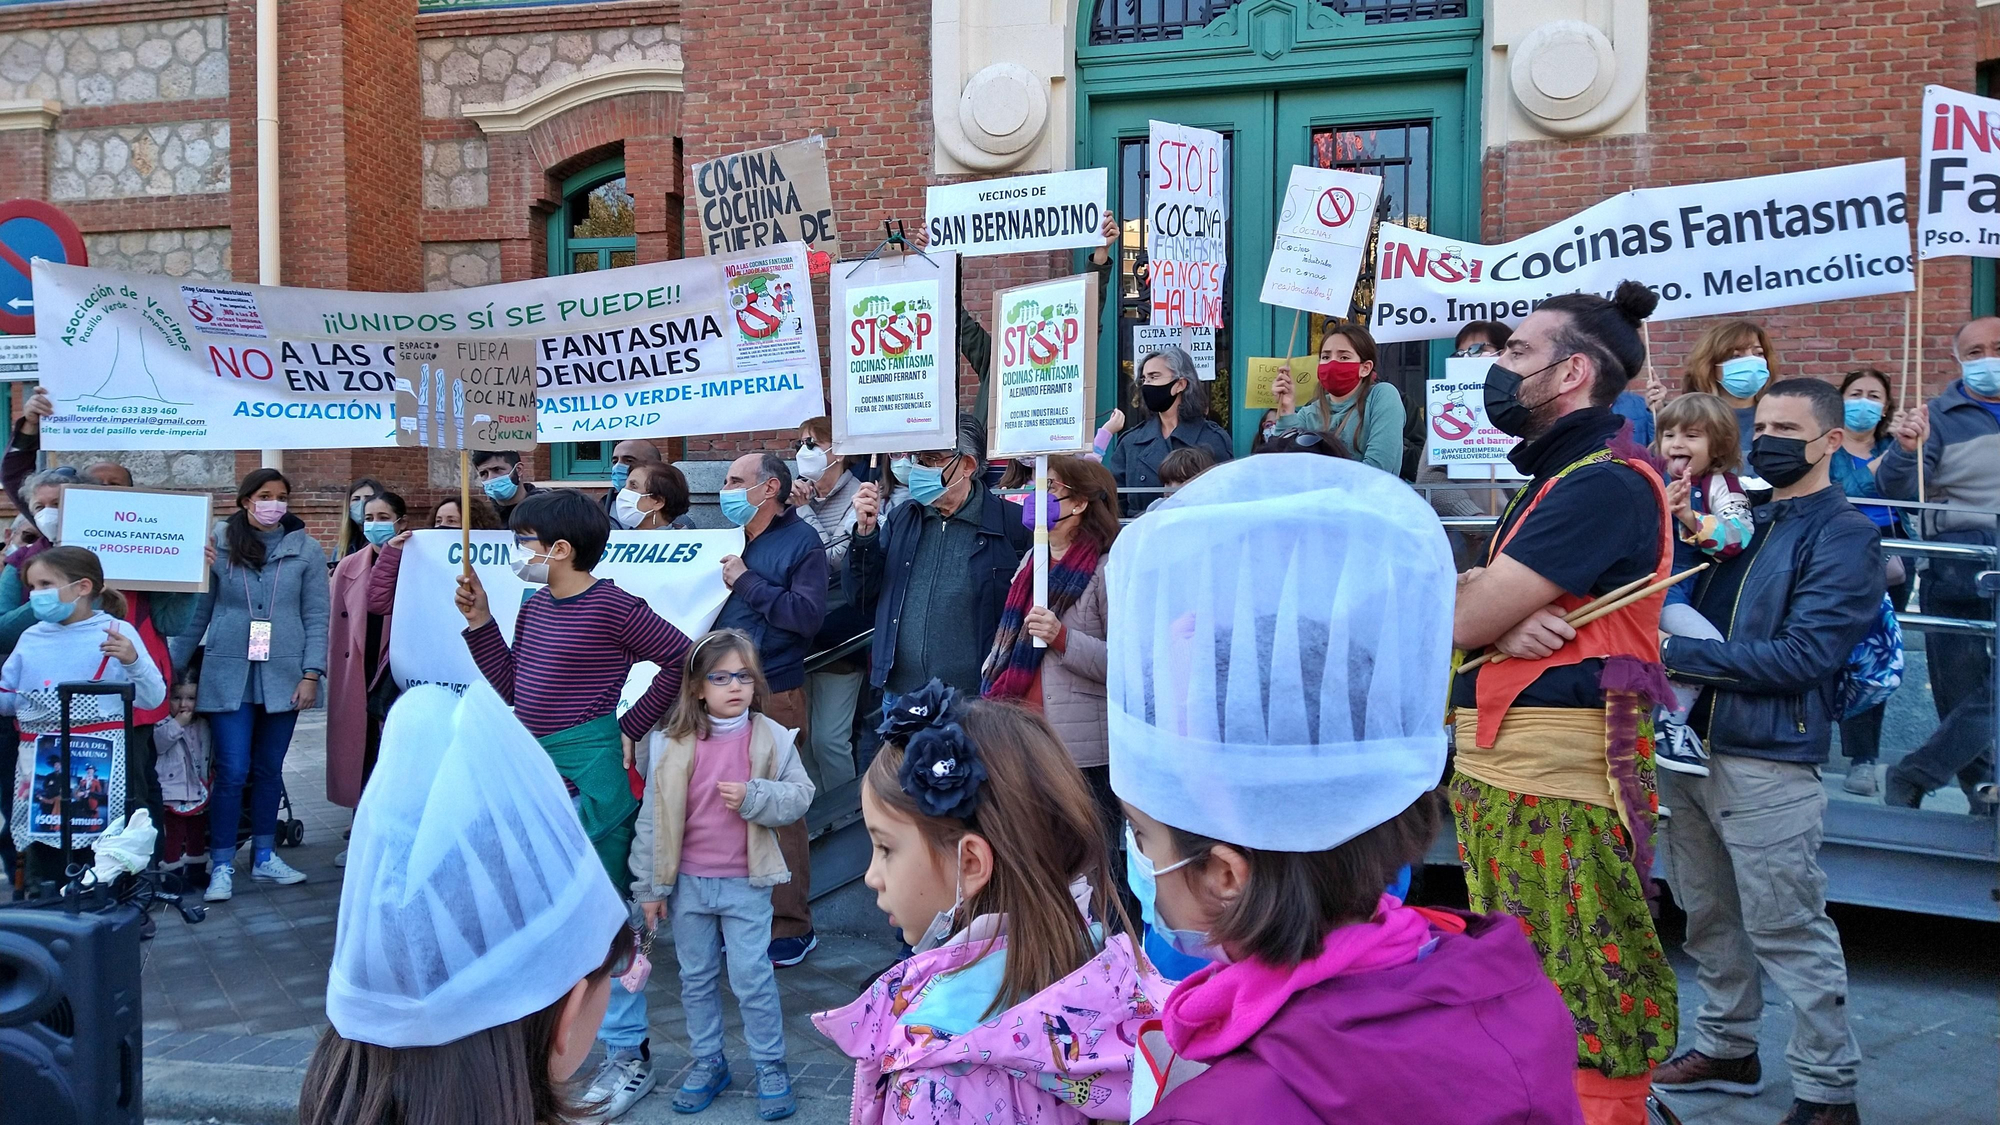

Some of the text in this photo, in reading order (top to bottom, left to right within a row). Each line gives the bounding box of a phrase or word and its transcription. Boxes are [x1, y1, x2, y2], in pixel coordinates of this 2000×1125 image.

[698, 151, 786, 198] COCINA
[1158, 140, 1219, 197] STOP
[978, 186, 1046, 203] VECINOS DE
[704, 181, 802, 231] COCHINA
[799, 209, 835, 245] DE
[930, 202, 1099, 247] SAN BERNARDINO
[1154, 202, 1221, 239] COCINA
[1490, 219, 1672, 282] Cocinas
[1679, 191, 1908, 249] Fantasma
[1925, 229, 1971, 247] Pso.
[1154, 235, 1224, 262] FANTASMA
[749, 260, 768, 269] COCINAS
[769, 256, 793, 265] FANTASMA
[1377, 302, 1437, 326] Pso.
[1703, 252, 1915, 297] Melancólicos
[467, 300, 494, 331] SÍ
[508, 303, 546, 327] SE
[560, 284, 681, 321] PUEDE!!
[61, 284, 191, 352] Asociación de Vecinos
[79, 314, 102, 343] Pasillo
[102, 301, 128, 314] Verde
[141, 309, 177, 347] Imperial
[209, 345, 273, 380] NO
[281, 342, 304, 365] A
[311, 343, 371, 366] LAS
[542, 315, 722, 361] FANTASMA
[457, 342, 509, 361] FUERA
[850, 354, 934, 374] COCINAS FANTASMA
[284, 369, 330, 391] EN
[460, 366, 531, 386] COCINA
[858, 370, 927, 385] ALEJANDRO FERRANT 8
[1003, 364, 1080, 386] COCINAS FANTASMA
[233, 399, 382, 419] ASOCIACIÓN
[624, 373, 804, 407] VERDE-IMPERIAL
[861, 392, 924, 404] COCINAS INDUSTRIALES
[1009, 382, 1073, 399] ALEJANDRO FERRANT 8
[1431, 383, 1456, 394] ¡Stop
[465, 389, 536, 409] COCHINA
[854, 401, 932, 413] FUERA DE ZONAS RESIDENCIALES
[76, 405, 119, 414] Teléfono:
[121, 406, 138, 414] 633
[140, 407, 158, 415] 839
[1010, 406, 1069, 420] COCINAS INDUSTRIALES
[91, 426, 105, 434] del
[107, 427, 137, 437] pasillo
[139, 428, 207, 438] verde-imperial
[572, 412, 661, 432] MADRID
[1004, 420, 1017, 430] FUERA
[1018, 420, 1024, 428] DE
[1039, 416, 1076, 427] RESIDENCIALES
[1476, 437, 1485, 445] el
[1487, 436, 1514, 445] barrio
[114, 511, 137, 522] NO
[84, 529, 185, 541] COCINAS FANTASMA
[99, 543, 180, 555] PROSPERIDAD
